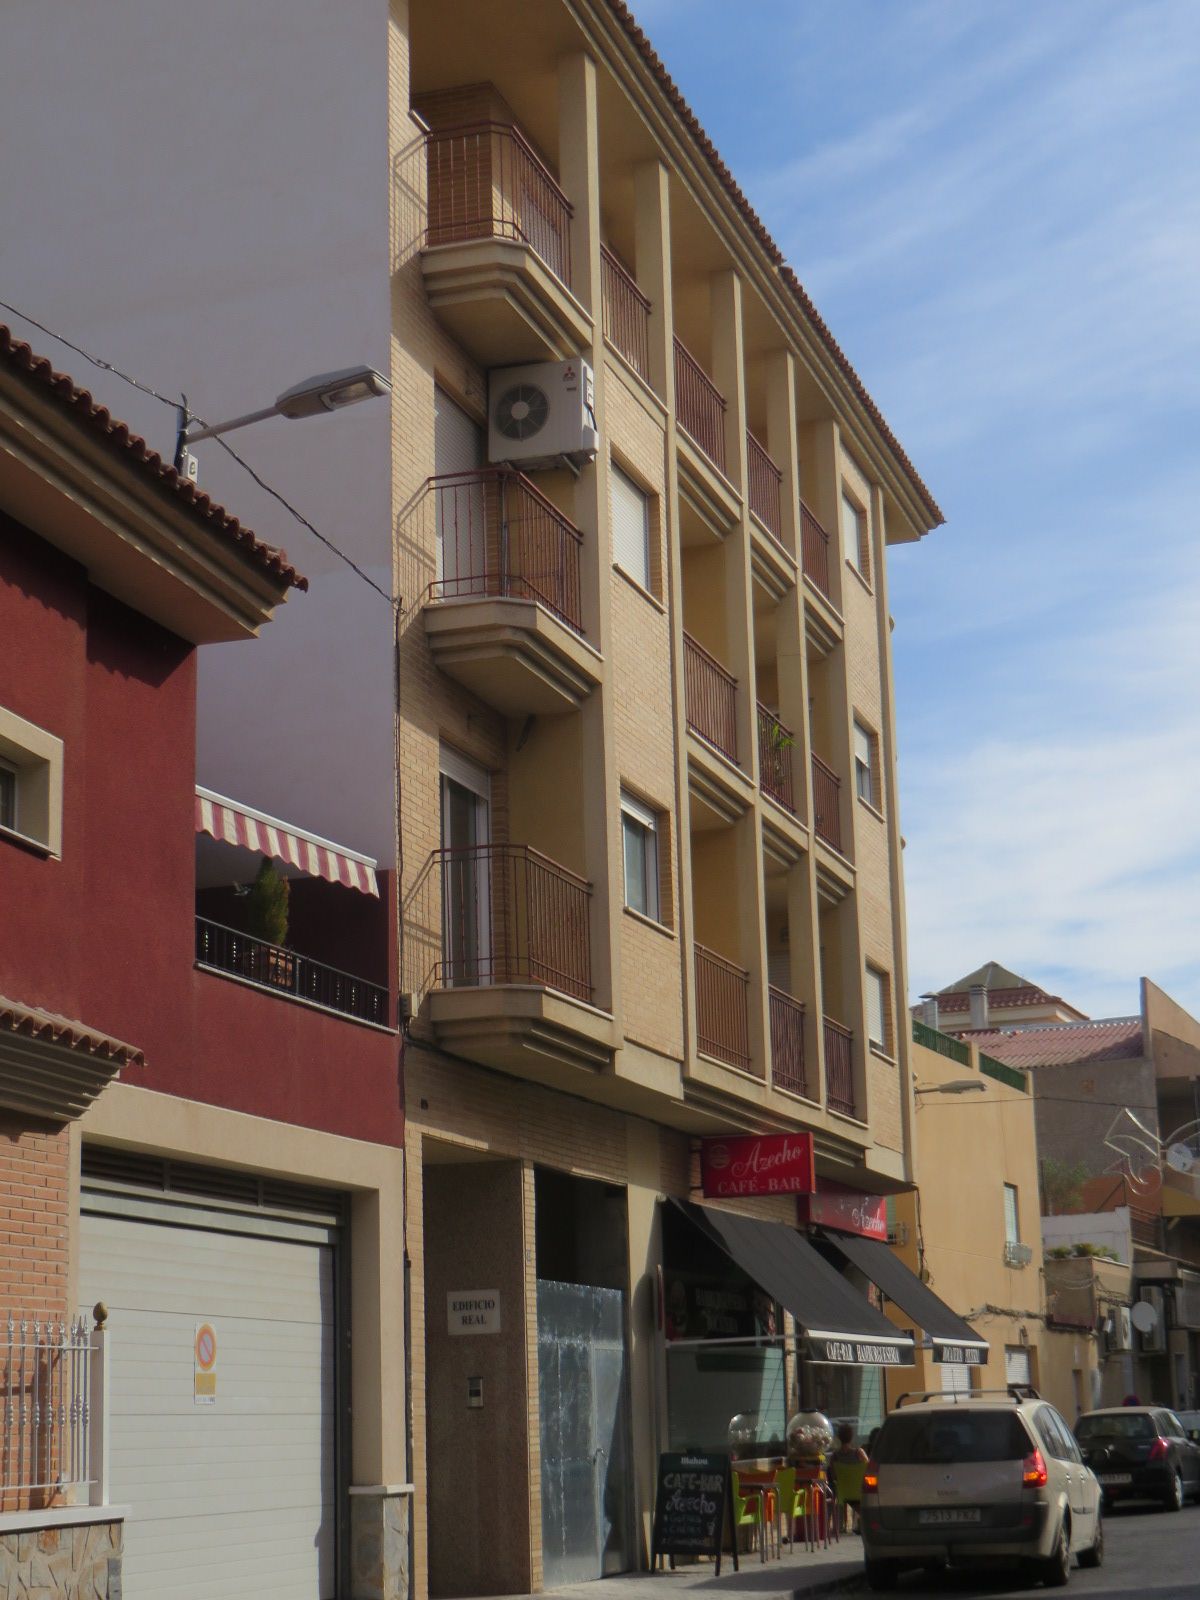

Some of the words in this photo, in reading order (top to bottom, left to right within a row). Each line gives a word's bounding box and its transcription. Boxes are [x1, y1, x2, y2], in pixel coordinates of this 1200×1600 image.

[731, 1139, 803, 1177] Azecho
[452, 1299, 495, 1311] EDIFICIO
[461, 1314, 487, 1325] REAL
[681, 1456, 708, 1465] Mahou
